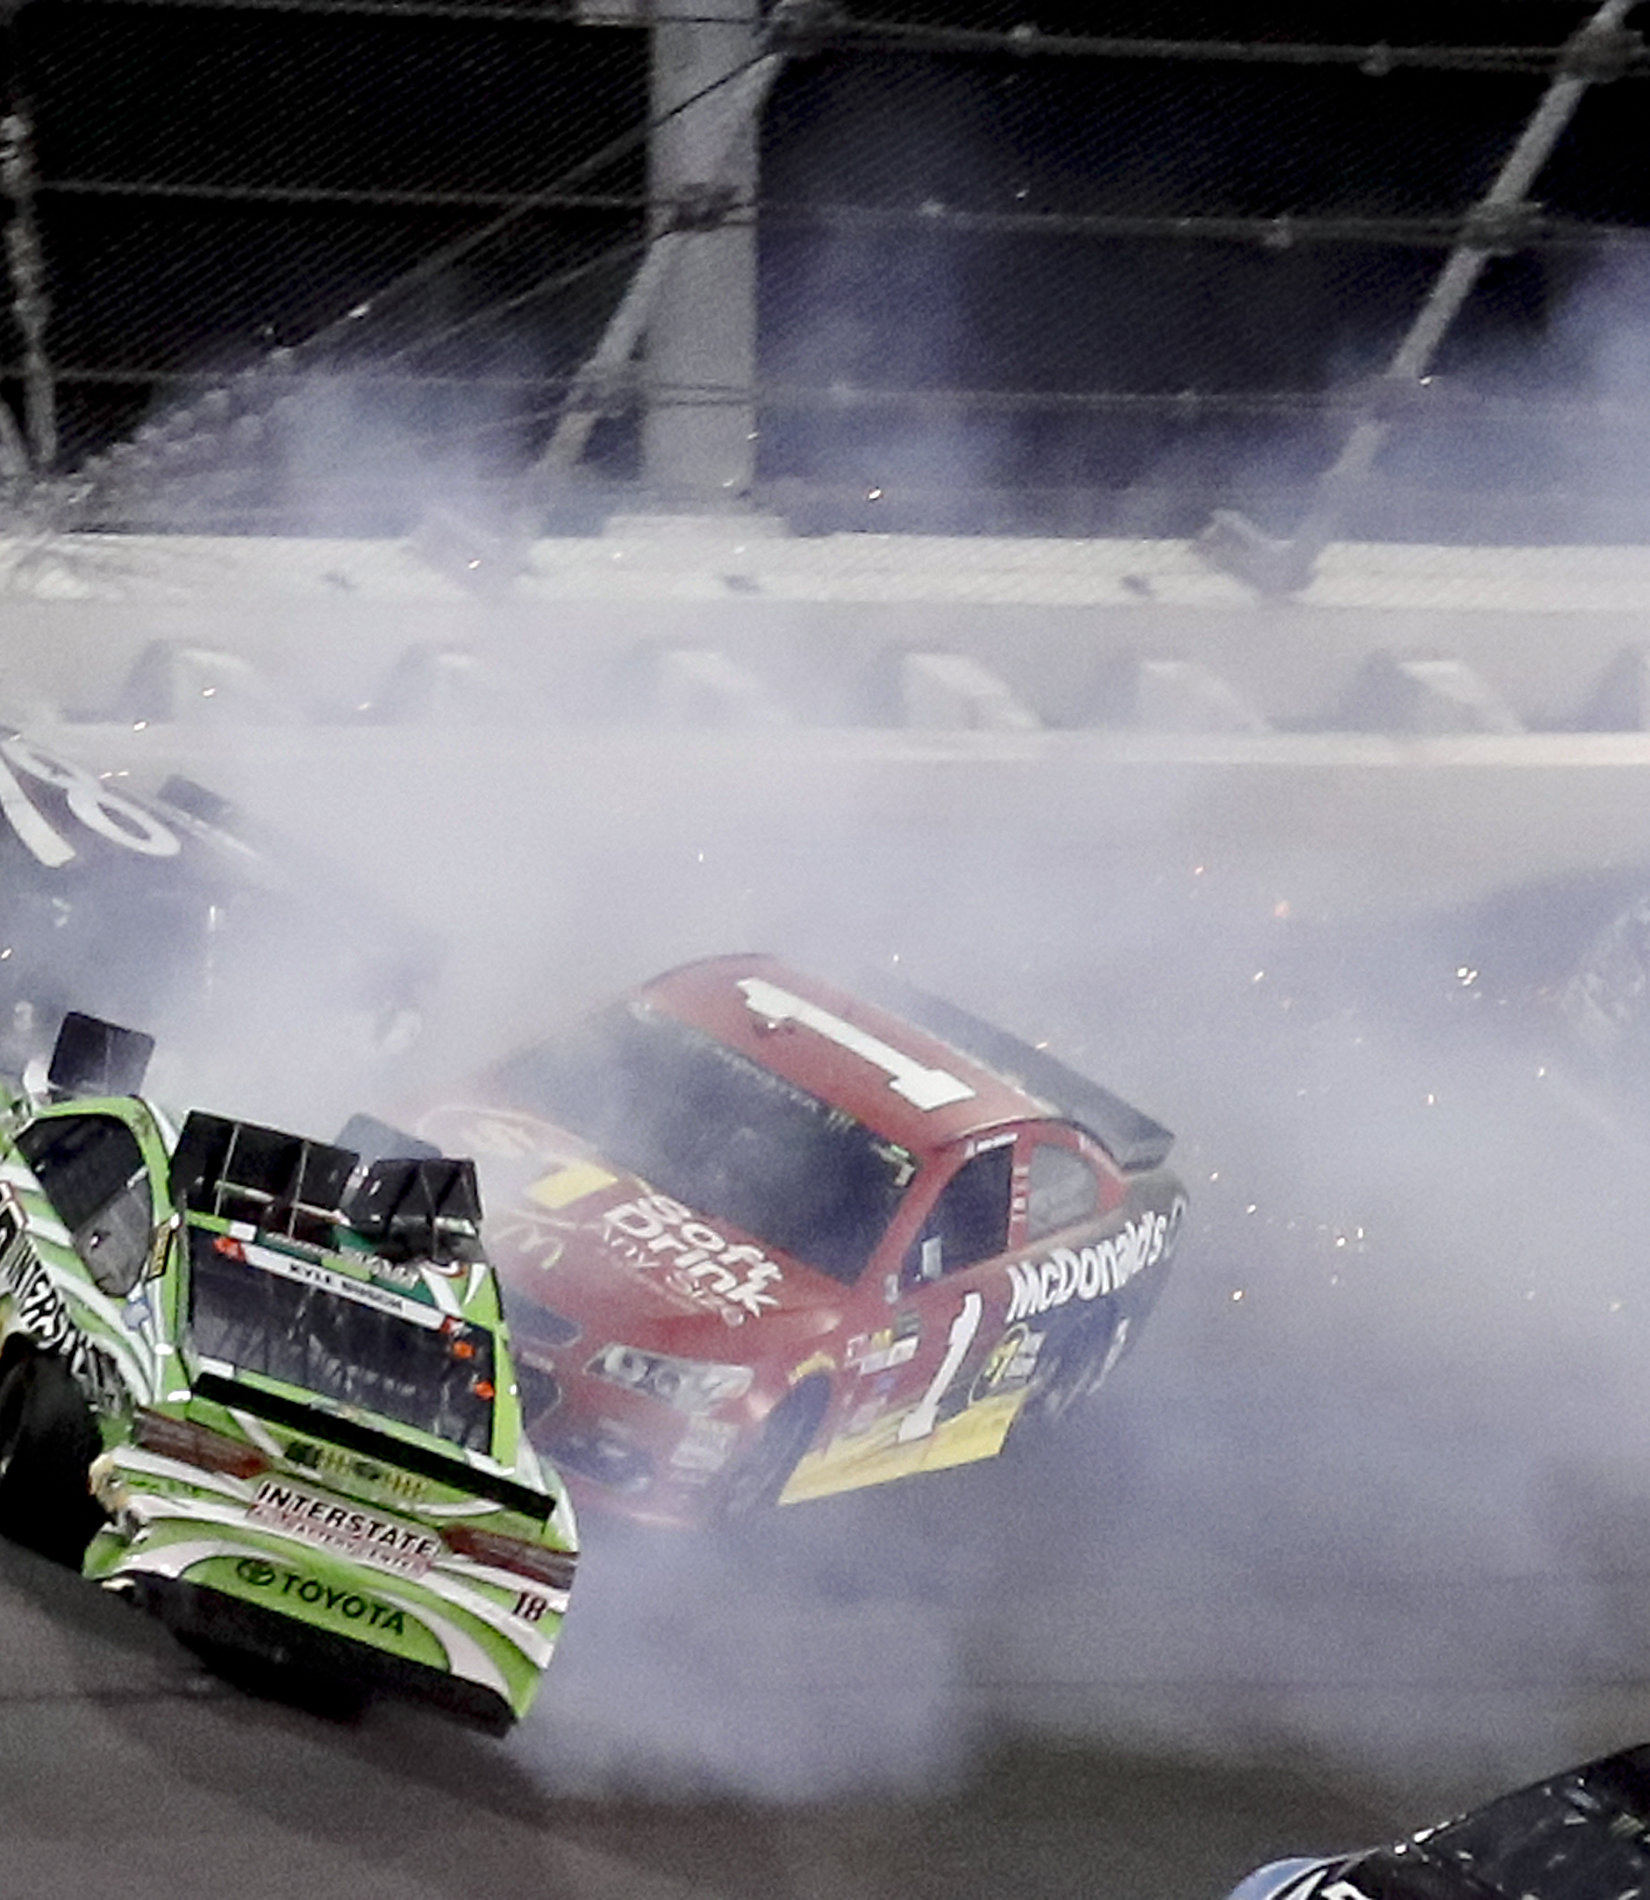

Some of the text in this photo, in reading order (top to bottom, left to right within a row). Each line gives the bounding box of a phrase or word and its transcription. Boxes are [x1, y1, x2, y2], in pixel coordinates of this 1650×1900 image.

[736, 977, 977, 1113] 1
[602, 1203, 781, 1319] Drink
[637, 1195, 783, 1284] Soft
[898, 1292, 983, 1443] 1
[256, 1481, 439, 1557] INTERSTATE
[282, 1572, 406, 1636] TOYOTA
[512, 1591, 549, 1622] 18
